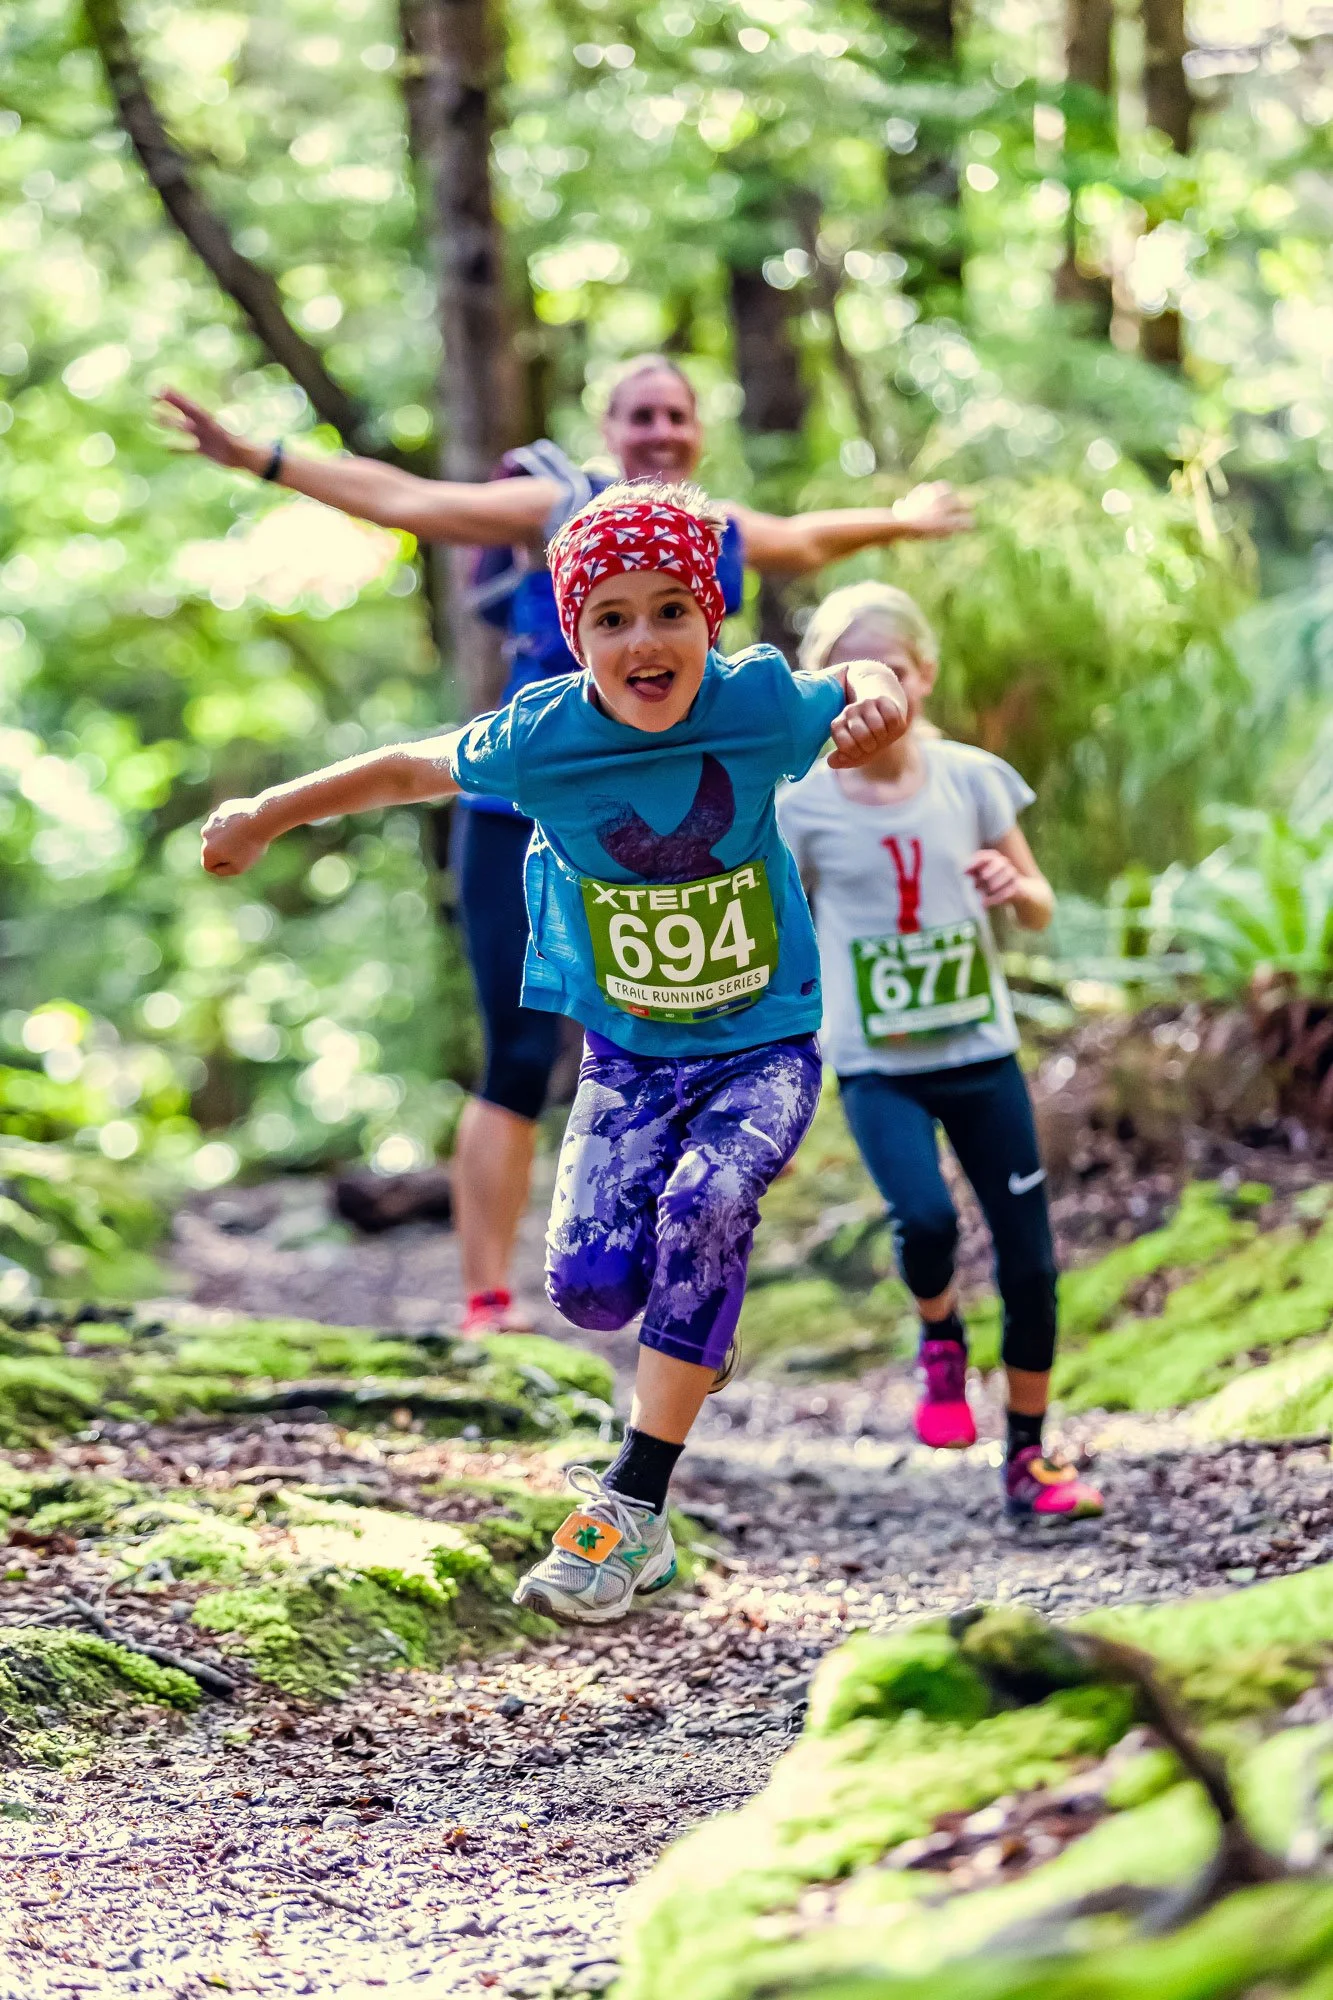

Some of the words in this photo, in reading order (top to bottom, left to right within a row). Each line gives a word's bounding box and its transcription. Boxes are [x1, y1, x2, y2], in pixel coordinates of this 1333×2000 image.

[593, 868, 756, 910] XTERRA
[609, 898, 756, 982] 694
[614, 981, 648, 1001] TRAIL
[653, 987, 714, 1004] RUNNING
[718, 973, 761, 996] SERIES
[870, 943, 976, 1012] 677
